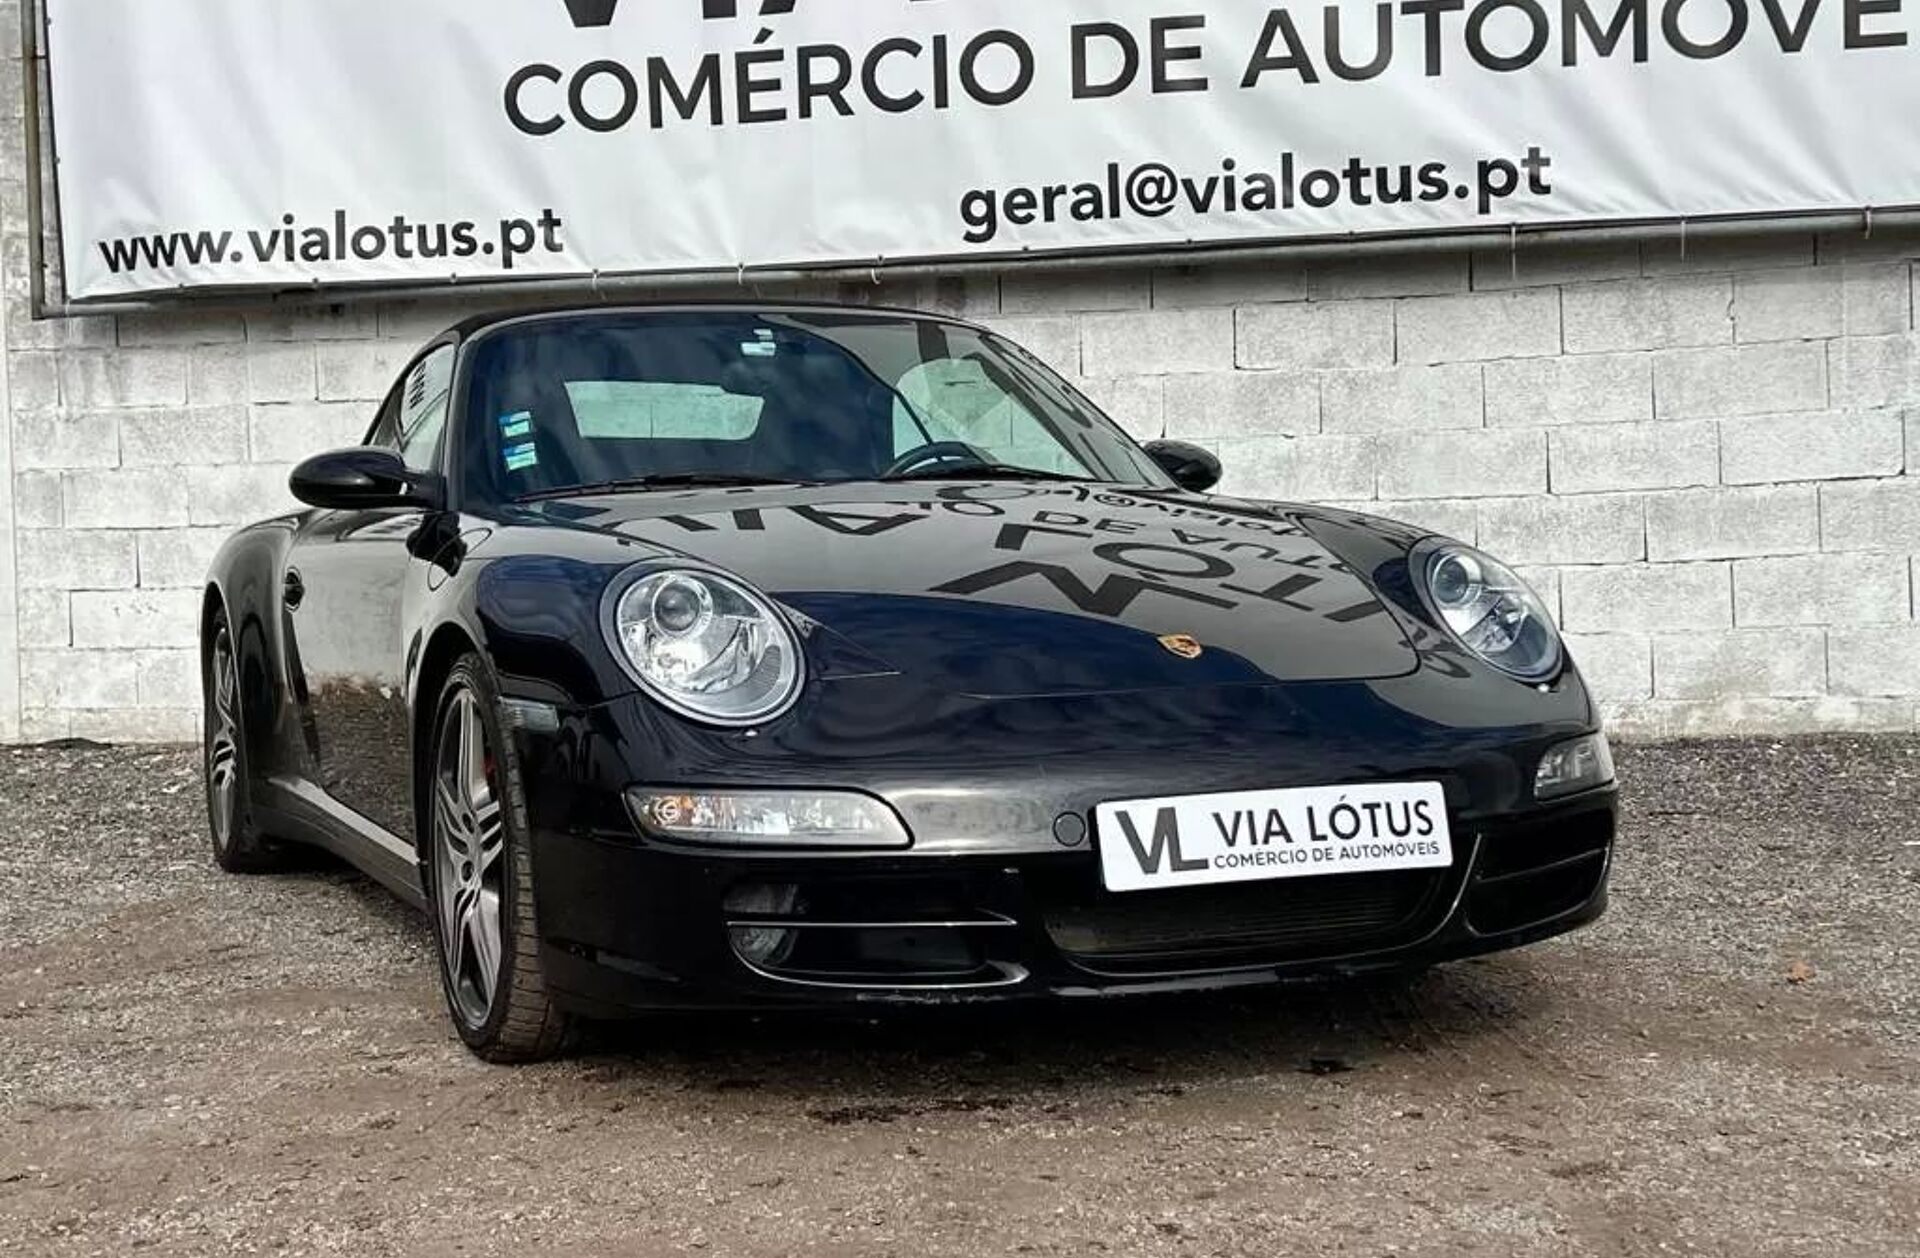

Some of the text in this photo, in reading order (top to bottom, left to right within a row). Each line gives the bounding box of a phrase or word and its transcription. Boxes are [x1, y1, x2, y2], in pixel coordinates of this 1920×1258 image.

[504, 27, 1035, 136] COMÉRCIO
[1071, 15, 1210, 99] DE
[960, 147, 1553, 244] geral@vialotus.pt
[99, 208, 564, 274] www.vialotus.pt
[1211, 794, 1435, 847] VIA LÓTUS
[1311, 846, 1335, 863] DE
